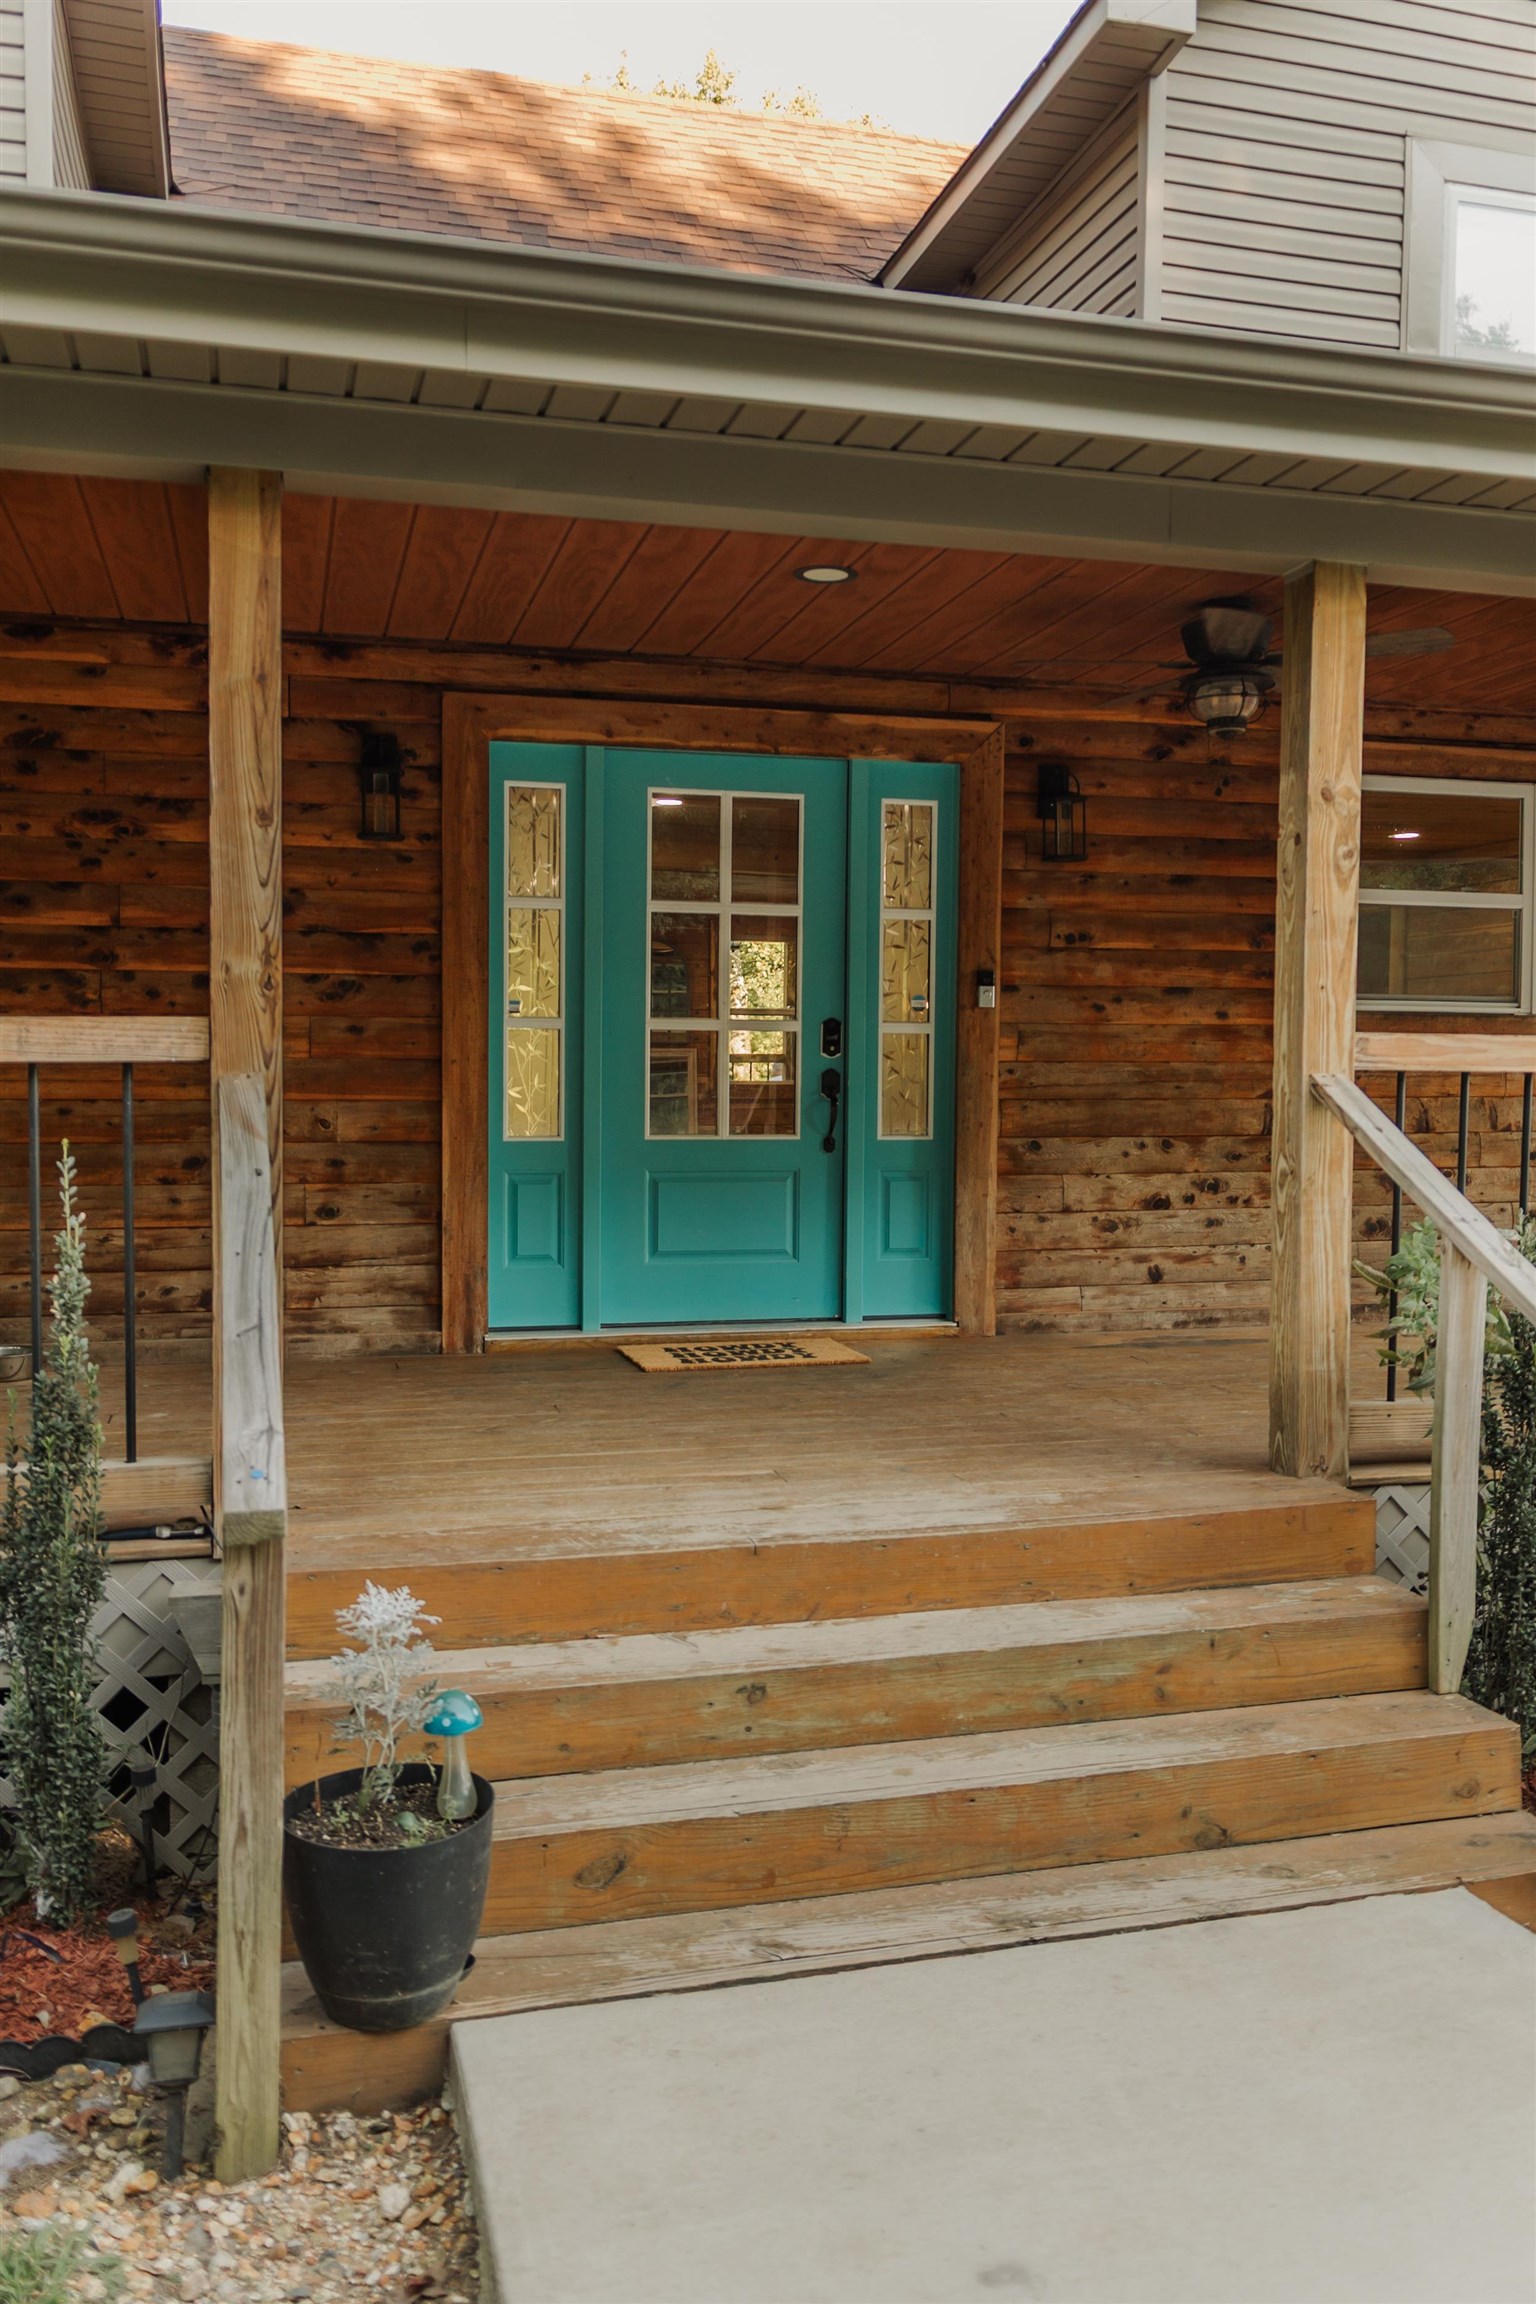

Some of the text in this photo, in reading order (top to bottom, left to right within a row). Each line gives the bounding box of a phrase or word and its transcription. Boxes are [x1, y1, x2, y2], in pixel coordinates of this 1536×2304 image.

[663, 1342, 798, 1352] HOWDY
[672, 1347, 808, 1358] HOWDY
[680, 1353, 818, 1364] HOWDY
